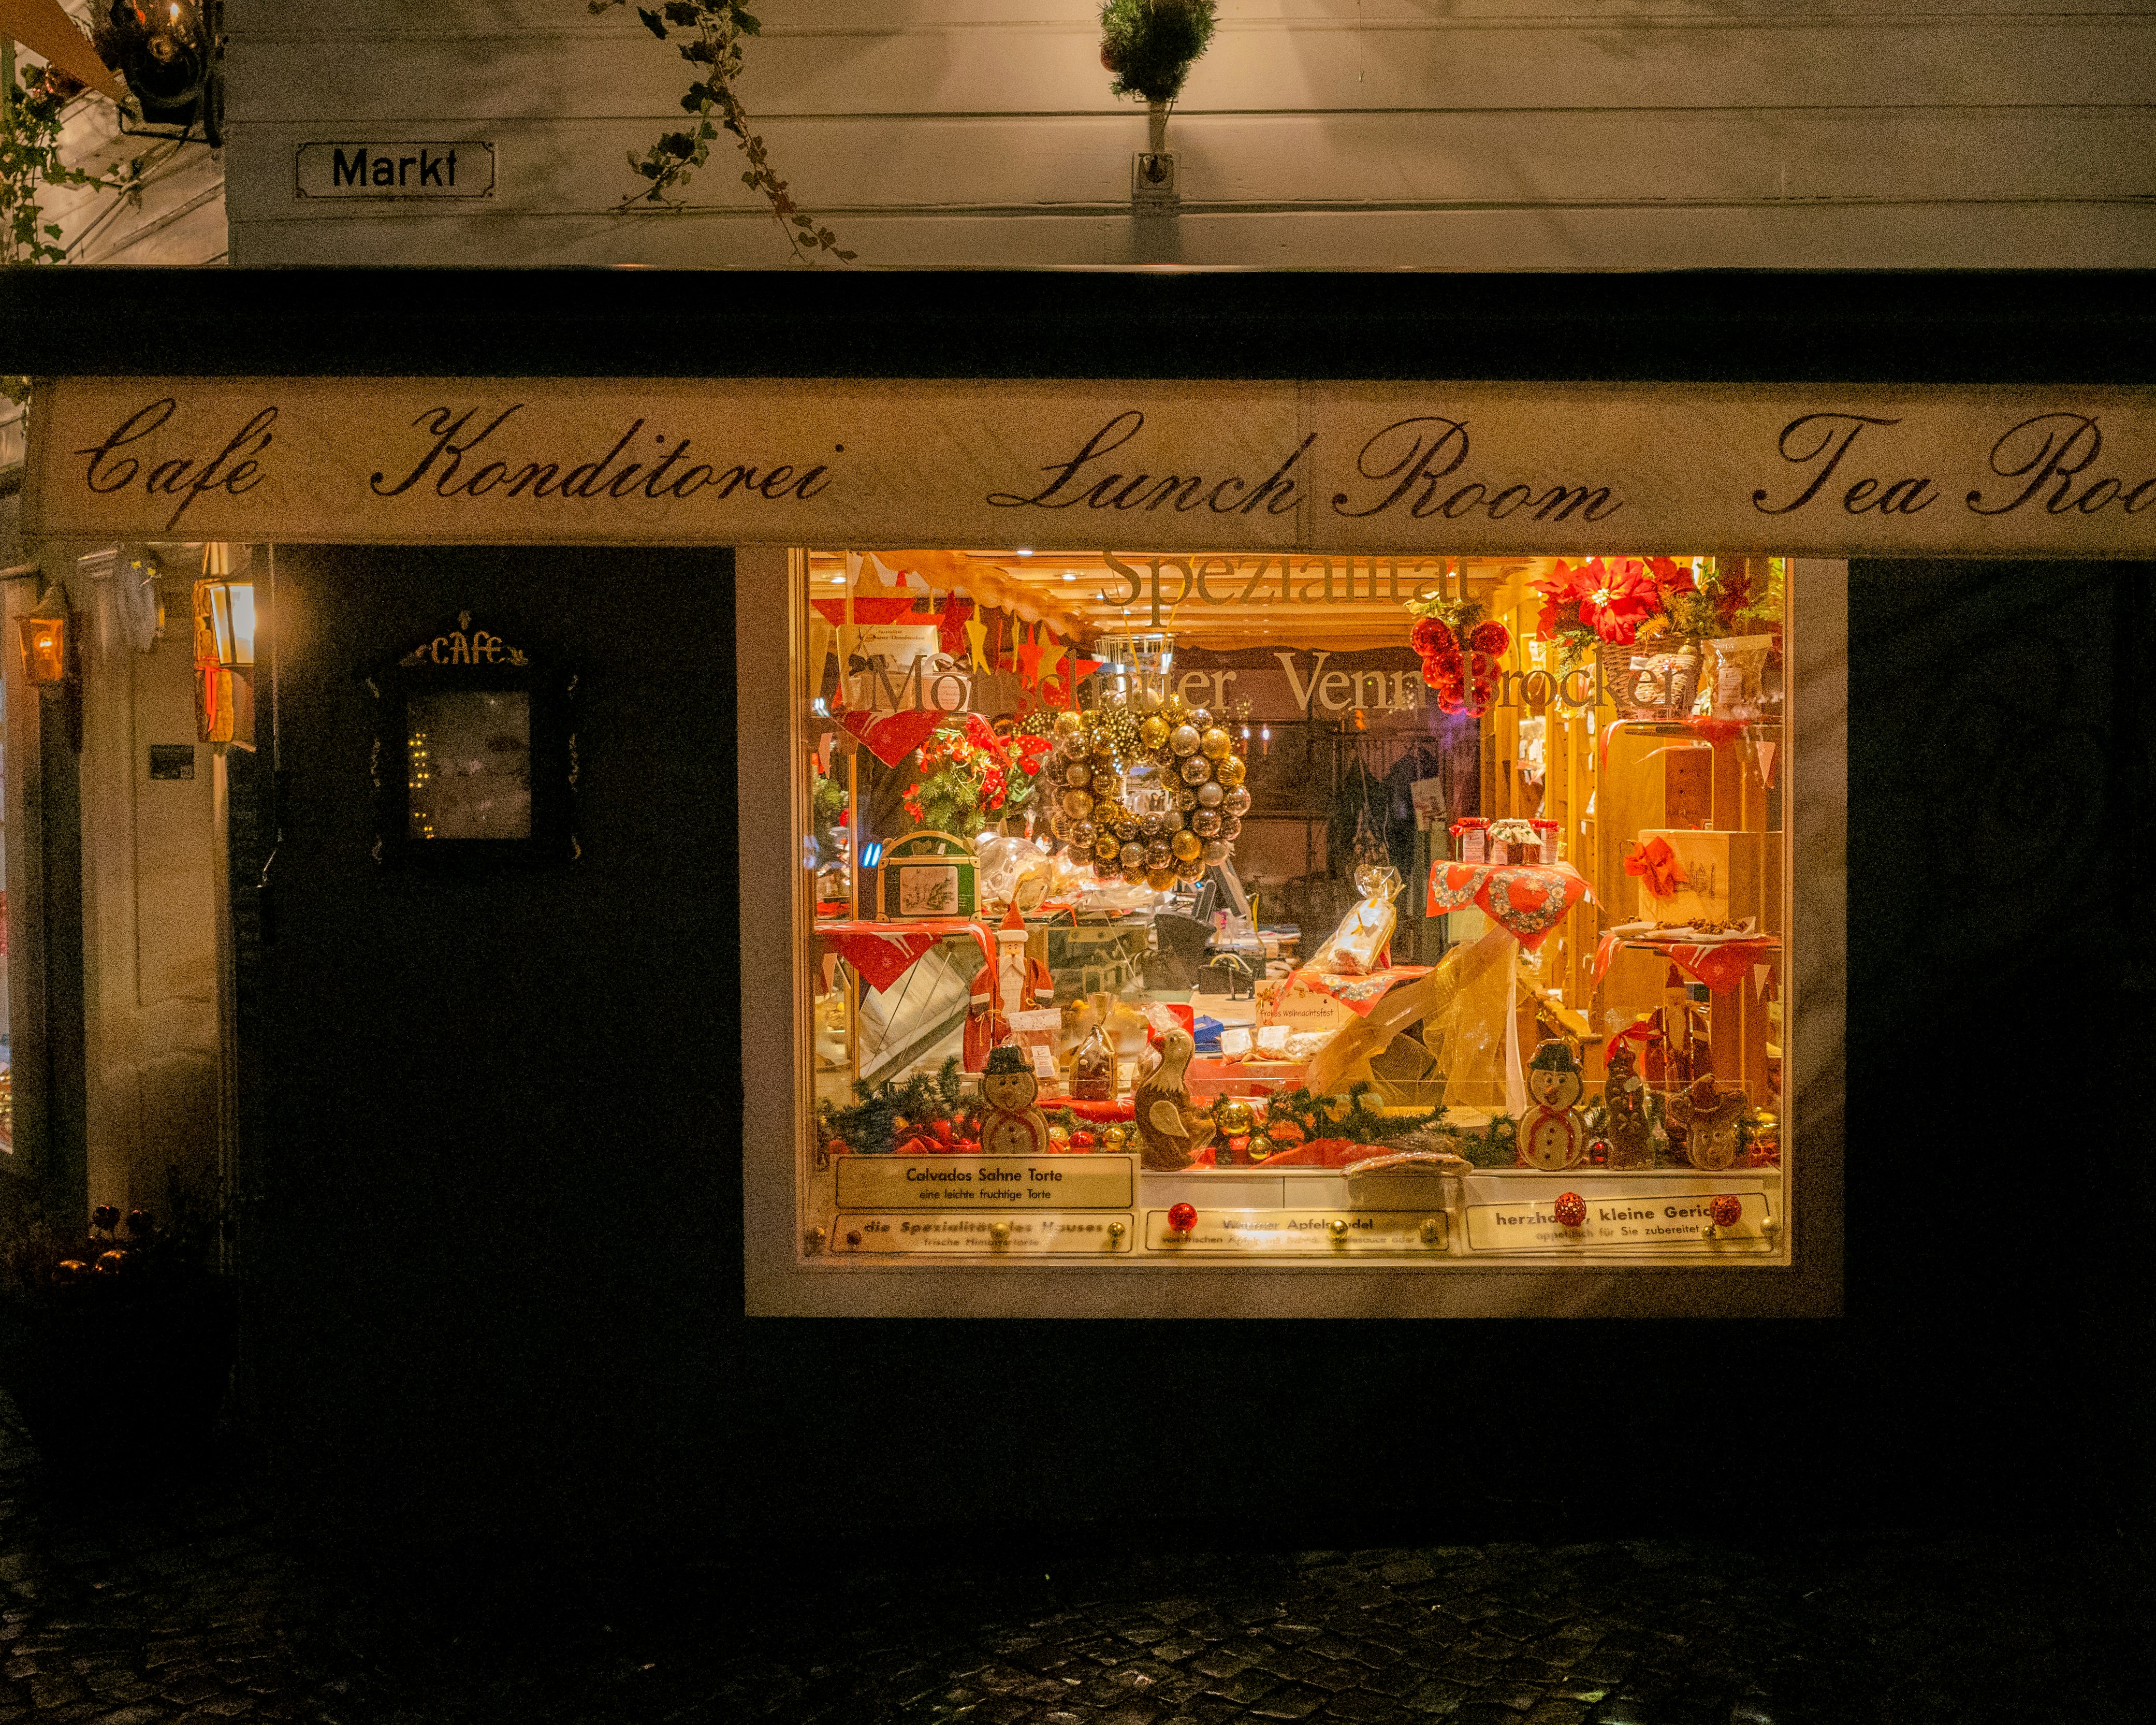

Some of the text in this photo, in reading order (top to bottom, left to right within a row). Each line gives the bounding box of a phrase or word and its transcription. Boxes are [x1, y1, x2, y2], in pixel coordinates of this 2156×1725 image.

[333, 149, 457, 186] Markt
[74, 397, 279, 531] Café
[371, 404, 845, 499] Konditorei
[986, 411, 1318, 515] Lunch
[1332, 416, 1623, 521] Room
[1752, 413, 1940, 515] Tea
[1261, 1009, 1281, 1018] Froes
[906, 1168, 1062, 1182] Calvados Sahne Torte
[920, 1190, 940, 1199] eine
[944, 1189, 974, 1199] leichte
[1027, 1189, 1051, 1199] Torte
[1599, 1208, 1654, 1221] kleine
[864, 1221, 890, 1233] die
[1287, 1219, 1373, 1231] Apfelsdel
[1622, 1226, 1638, 1236] Sie
[1645, 1224, 1699, 1236] zubereitet
